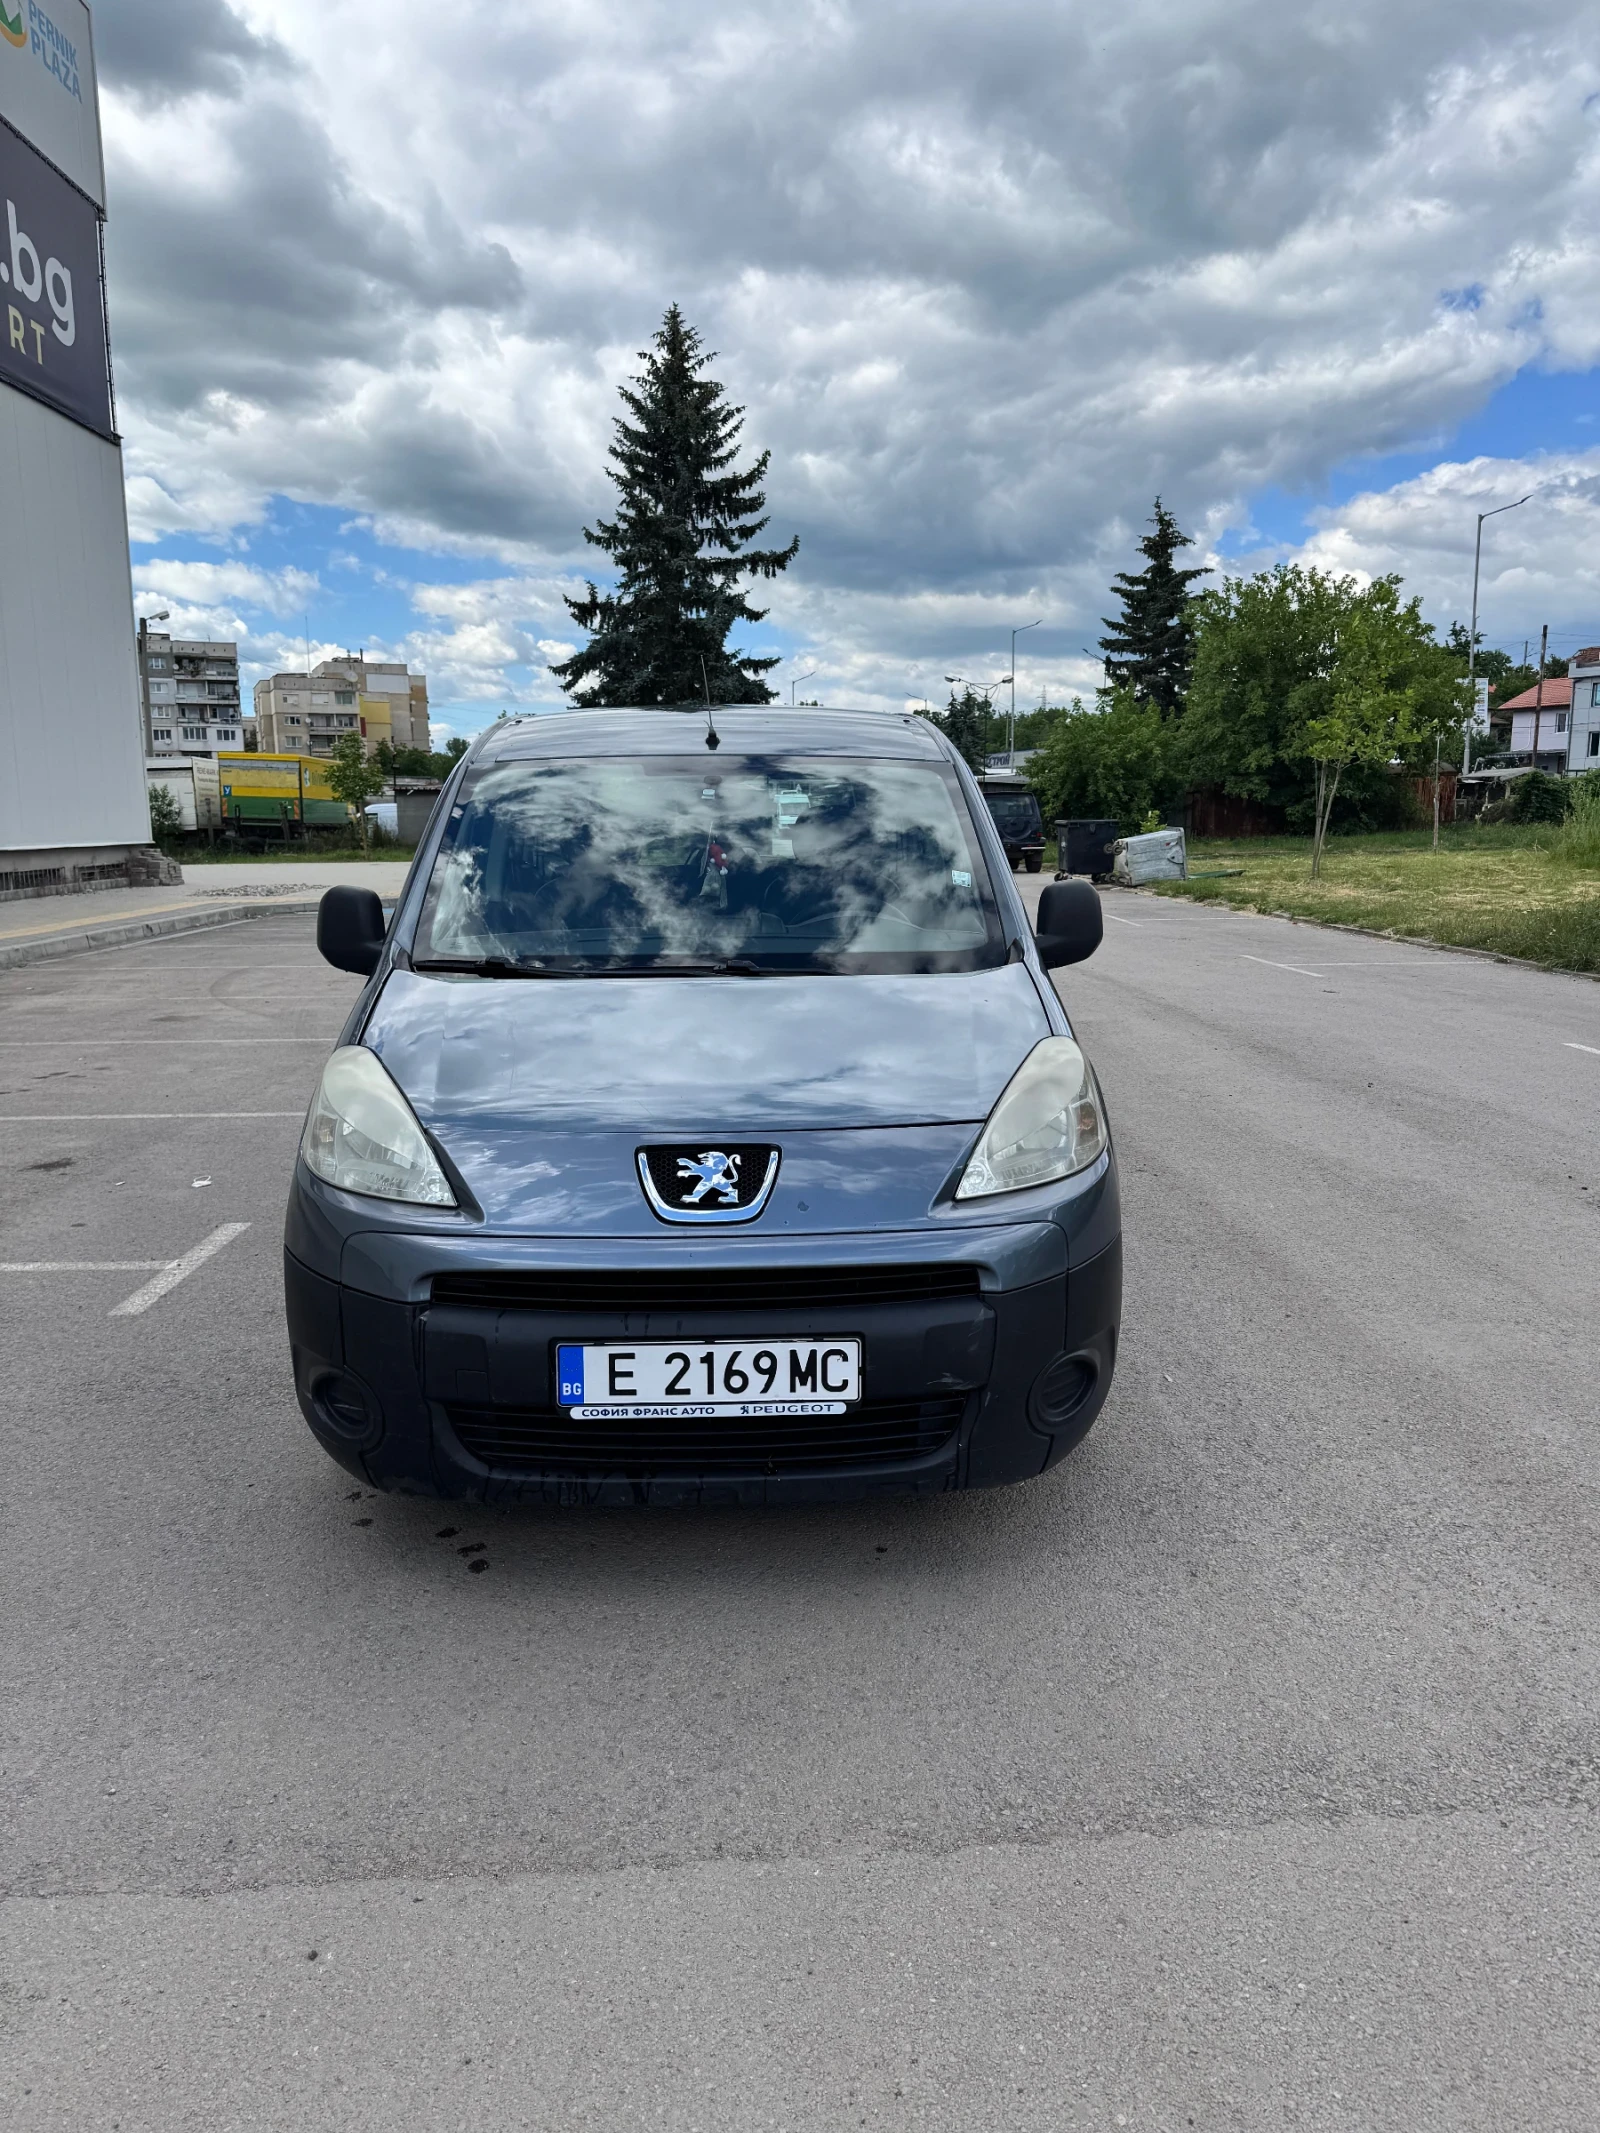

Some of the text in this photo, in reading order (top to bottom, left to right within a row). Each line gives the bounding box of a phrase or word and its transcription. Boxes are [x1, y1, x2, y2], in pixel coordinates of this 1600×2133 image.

[28, 0, 78, 71] PERNIK
[30, 26, 82, 104] PLAZA
[609, 1353, 637, 1396] E
[562, 1382, 582, 1396] BG
[581, 1406, 716, 1417] СОФИЯ ФРАНС АУТО
[752, 1403, 835, 1414] PEUGEOT
